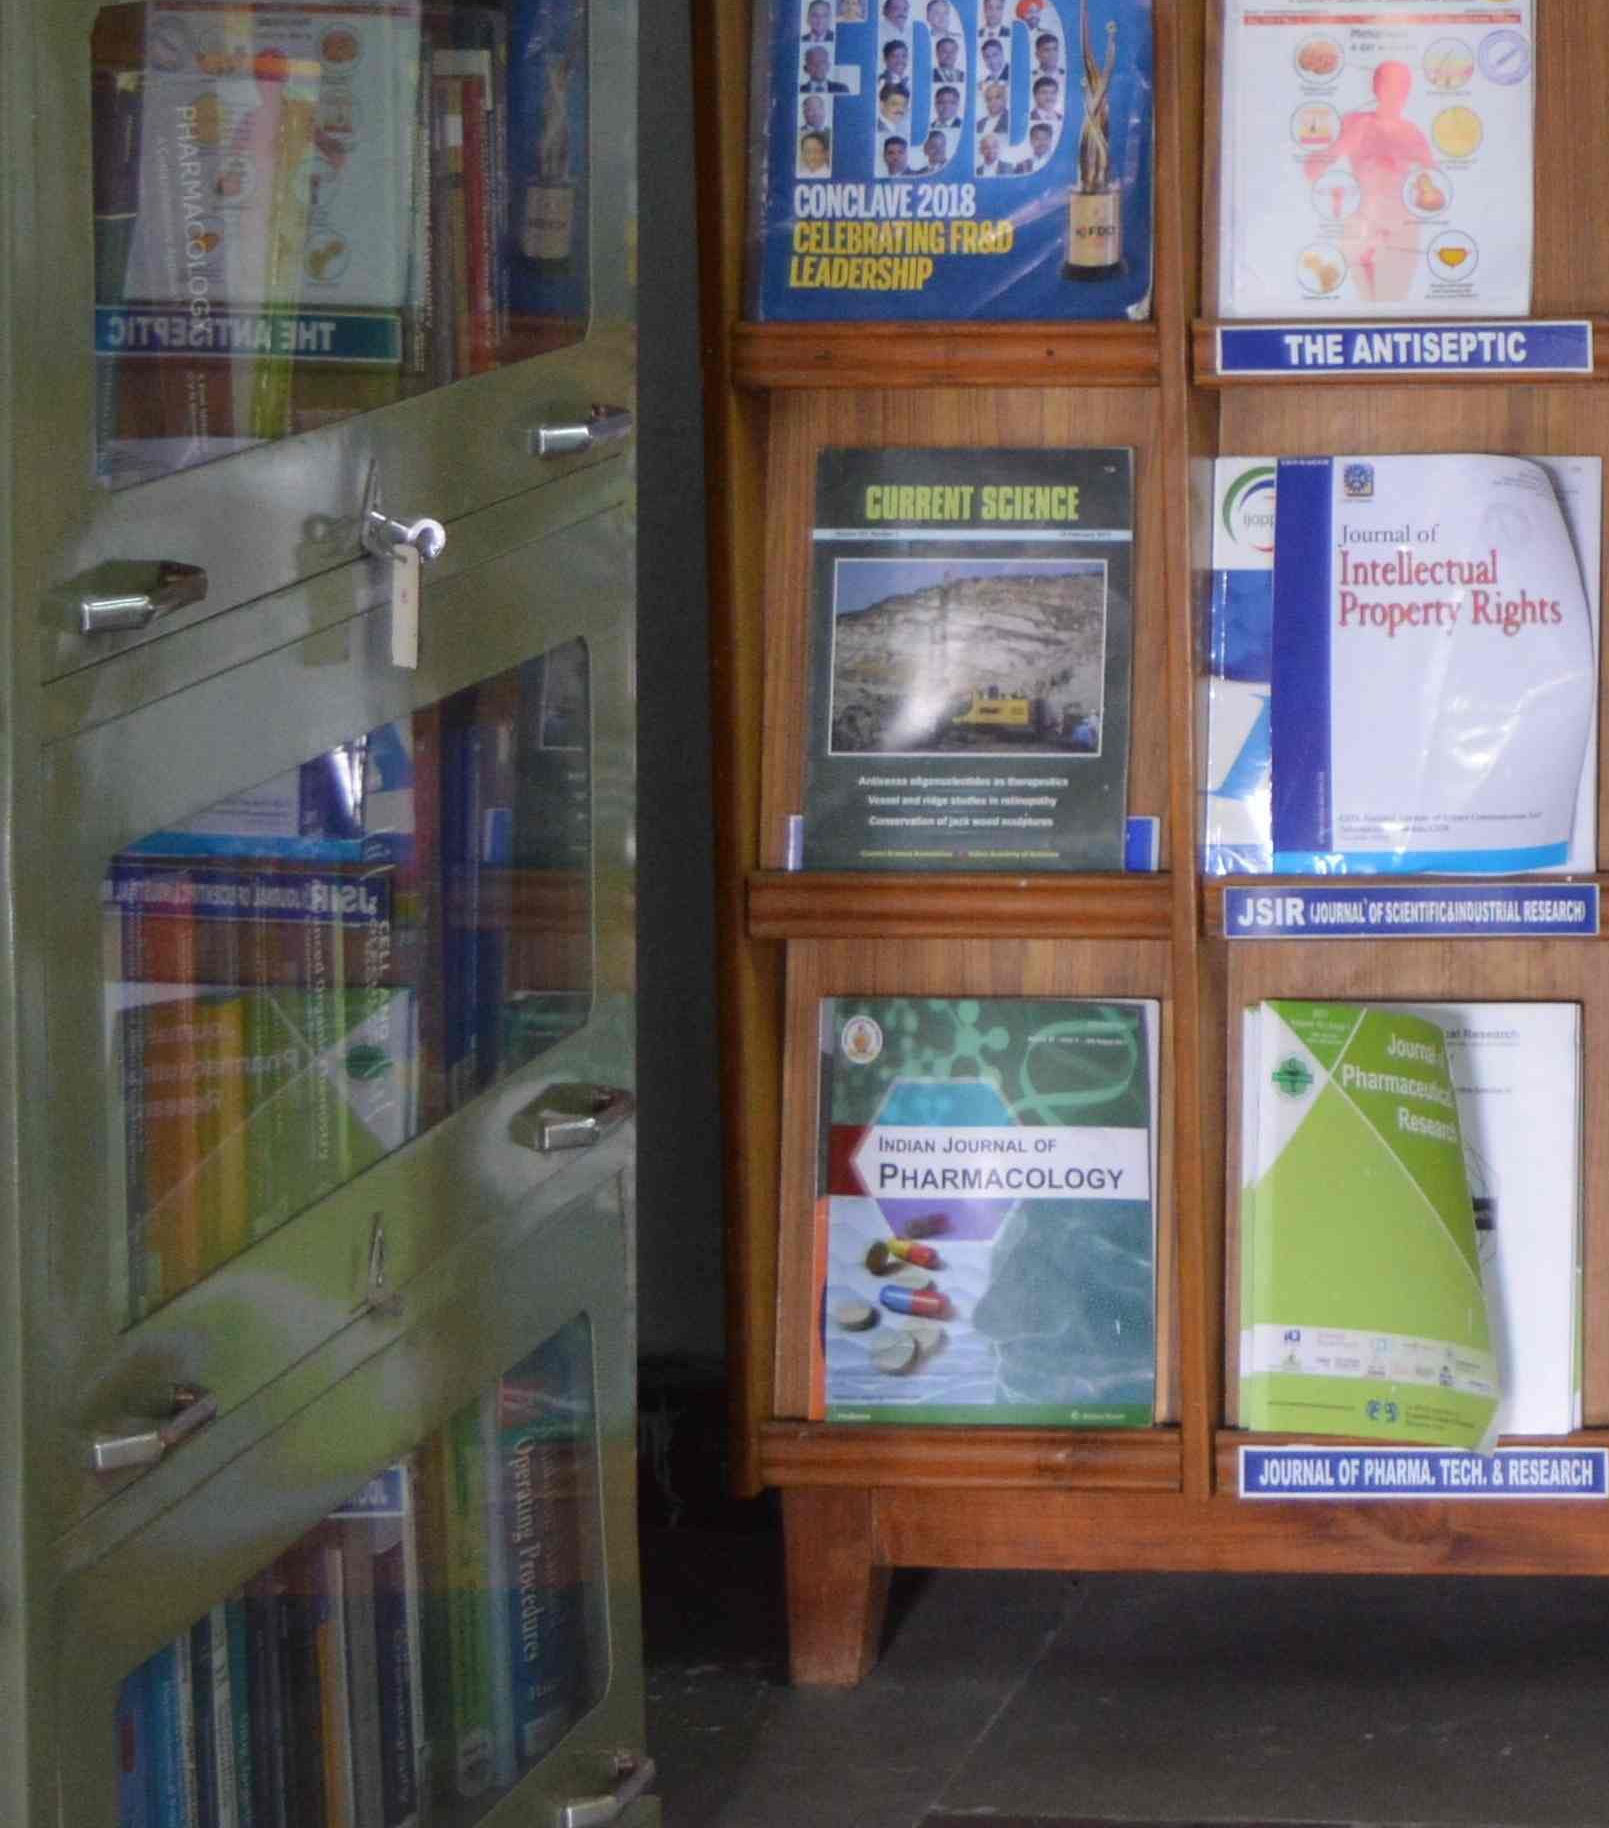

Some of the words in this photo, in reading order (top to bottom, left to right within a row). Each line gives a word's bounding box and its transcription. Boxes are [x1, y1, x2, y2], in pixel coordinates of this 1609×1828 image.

[794, 184, 912, 218] CONCLAVE
[917, 182, 976, 217] 2018
[789, 255, 934, 291] LEADERSHIP
[1285, 333, 1344, 366] THE
[1352, 331, 1527, 364] ANTISEPTIC
[865, 485, 974, 521] CURRENT
[981, 485, 1081, 521] SCIENCE
[1338, 524, 1411, 548] Journal
[1417, 523, 1439, 543] of
[1338, 549, 1498, 587] Intellectual
[1338, 589, 1464, 638] Property
[1472, 588, 1563, 636] Rights
[1259, 1458, 1334, 1488] JOURNAL
[1340, 1458, 1360, 1487] OF
[1364, 1458, 1436, 1487] PHARMA.
[1440, 1458, 1488, 1487] TECH.
[1491, 1459, 1505, 1487] &
[1509, 1458, 1593, 1487] RESEARCH
